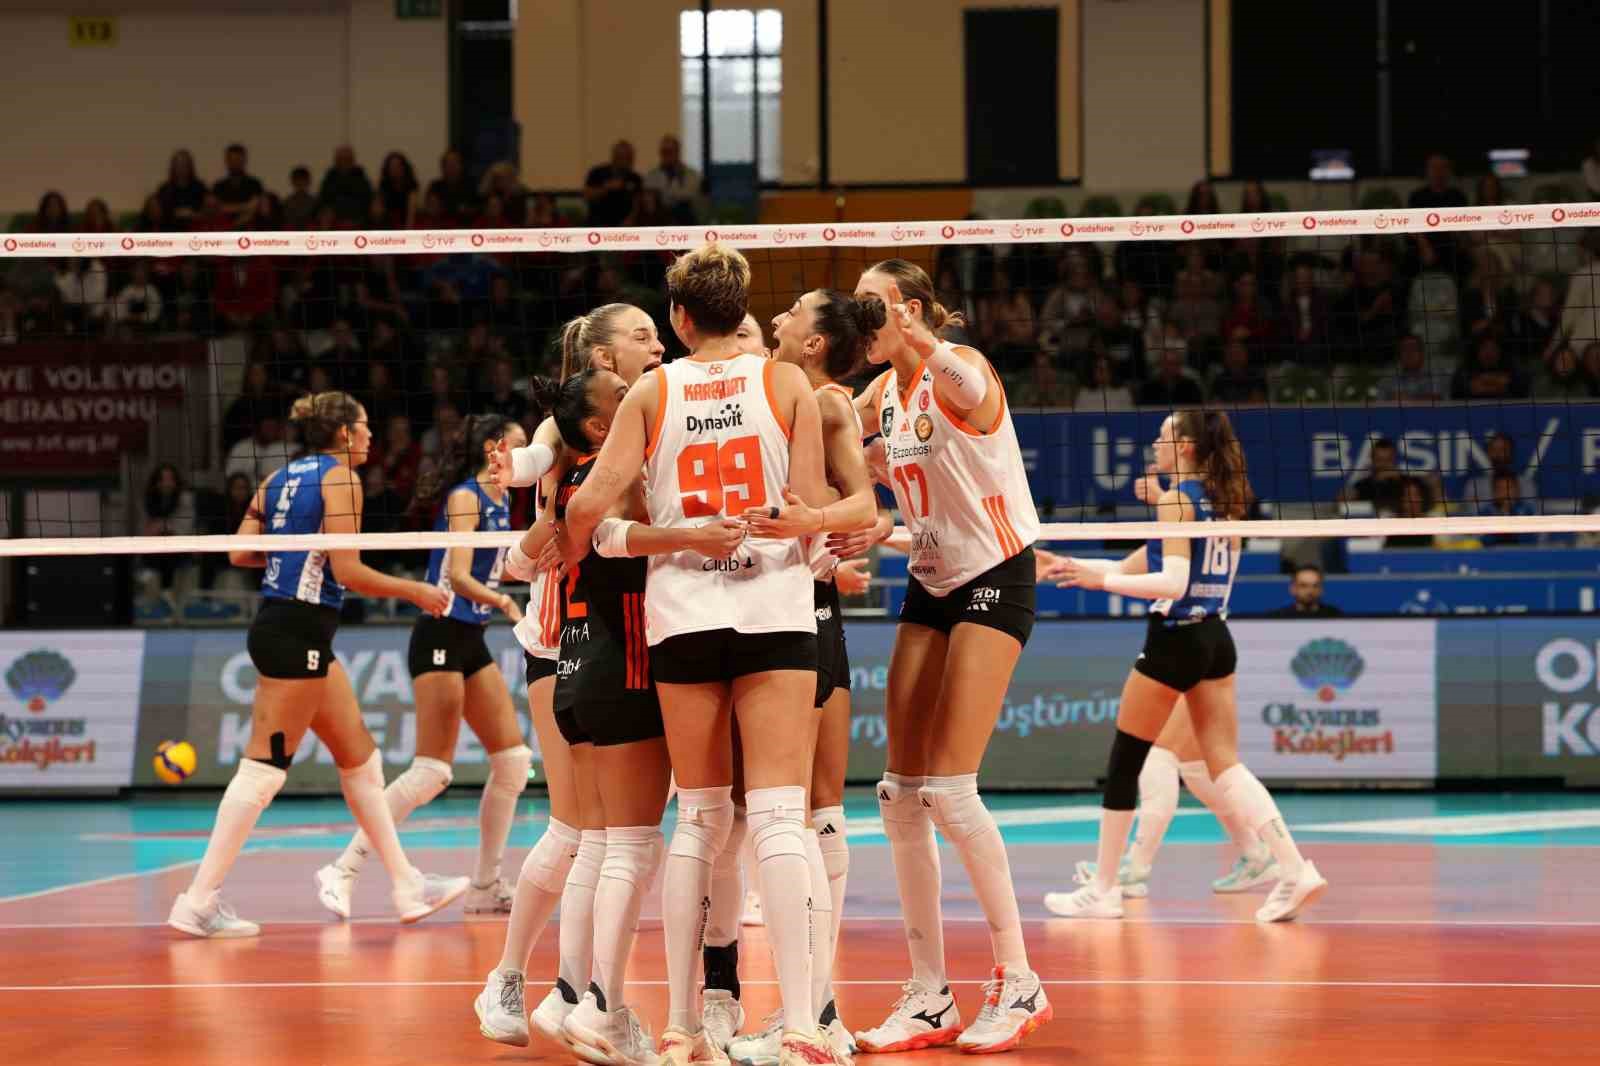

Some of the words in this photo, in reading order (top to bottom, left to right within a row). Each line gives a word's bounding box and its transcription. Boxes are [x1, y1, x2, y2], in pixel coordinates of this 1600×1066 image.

[18, 240, 57, 248] vodafone
[136, 239, 174, 248] vodafone
[252, 238, 290, 246] vodafone
[370, 236, 407, 245] vodafone
[486, 232, 524, 243] vodafone
[603, 231, 640, 242] vodafone
[720, 231, 757, 240] vodafone
[838, 229, 876, 238] vodafone
[956, 227, 994, 235] vodafone
[1075, 223, 1115, 233] vodafone
[1196, 220, 1235, 230] vodafone
[1318, 217, 1358, 226] vodafone
[1442, 213, 1482, 222] vodafone
[686, 409, 744, 434] Dynavit
[676, 435, 766, 518] 99
[893, 463, 929, 518] 17
[1261, 703, 1380, 732] Okyanus
[0, 738, 96, 769] olejleri
